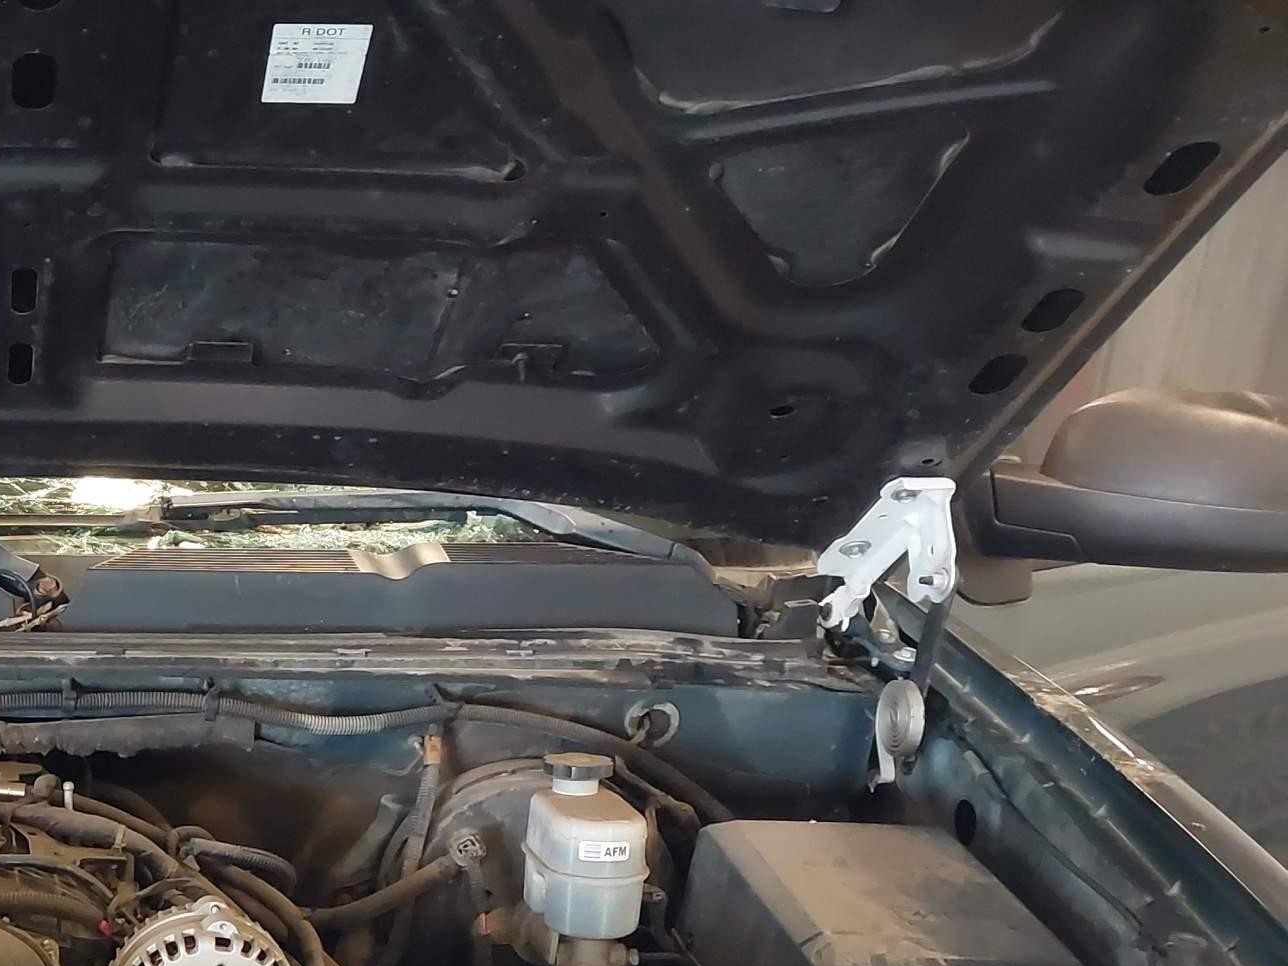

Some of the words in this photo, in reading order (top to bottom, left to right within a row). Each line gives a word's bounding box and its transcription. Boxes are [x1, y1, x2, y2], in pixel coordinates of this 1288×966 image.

[302, 28, 311, 36] R
[316, 28, 346, 36] DOT
[604, 846, 627, 857] AFM
